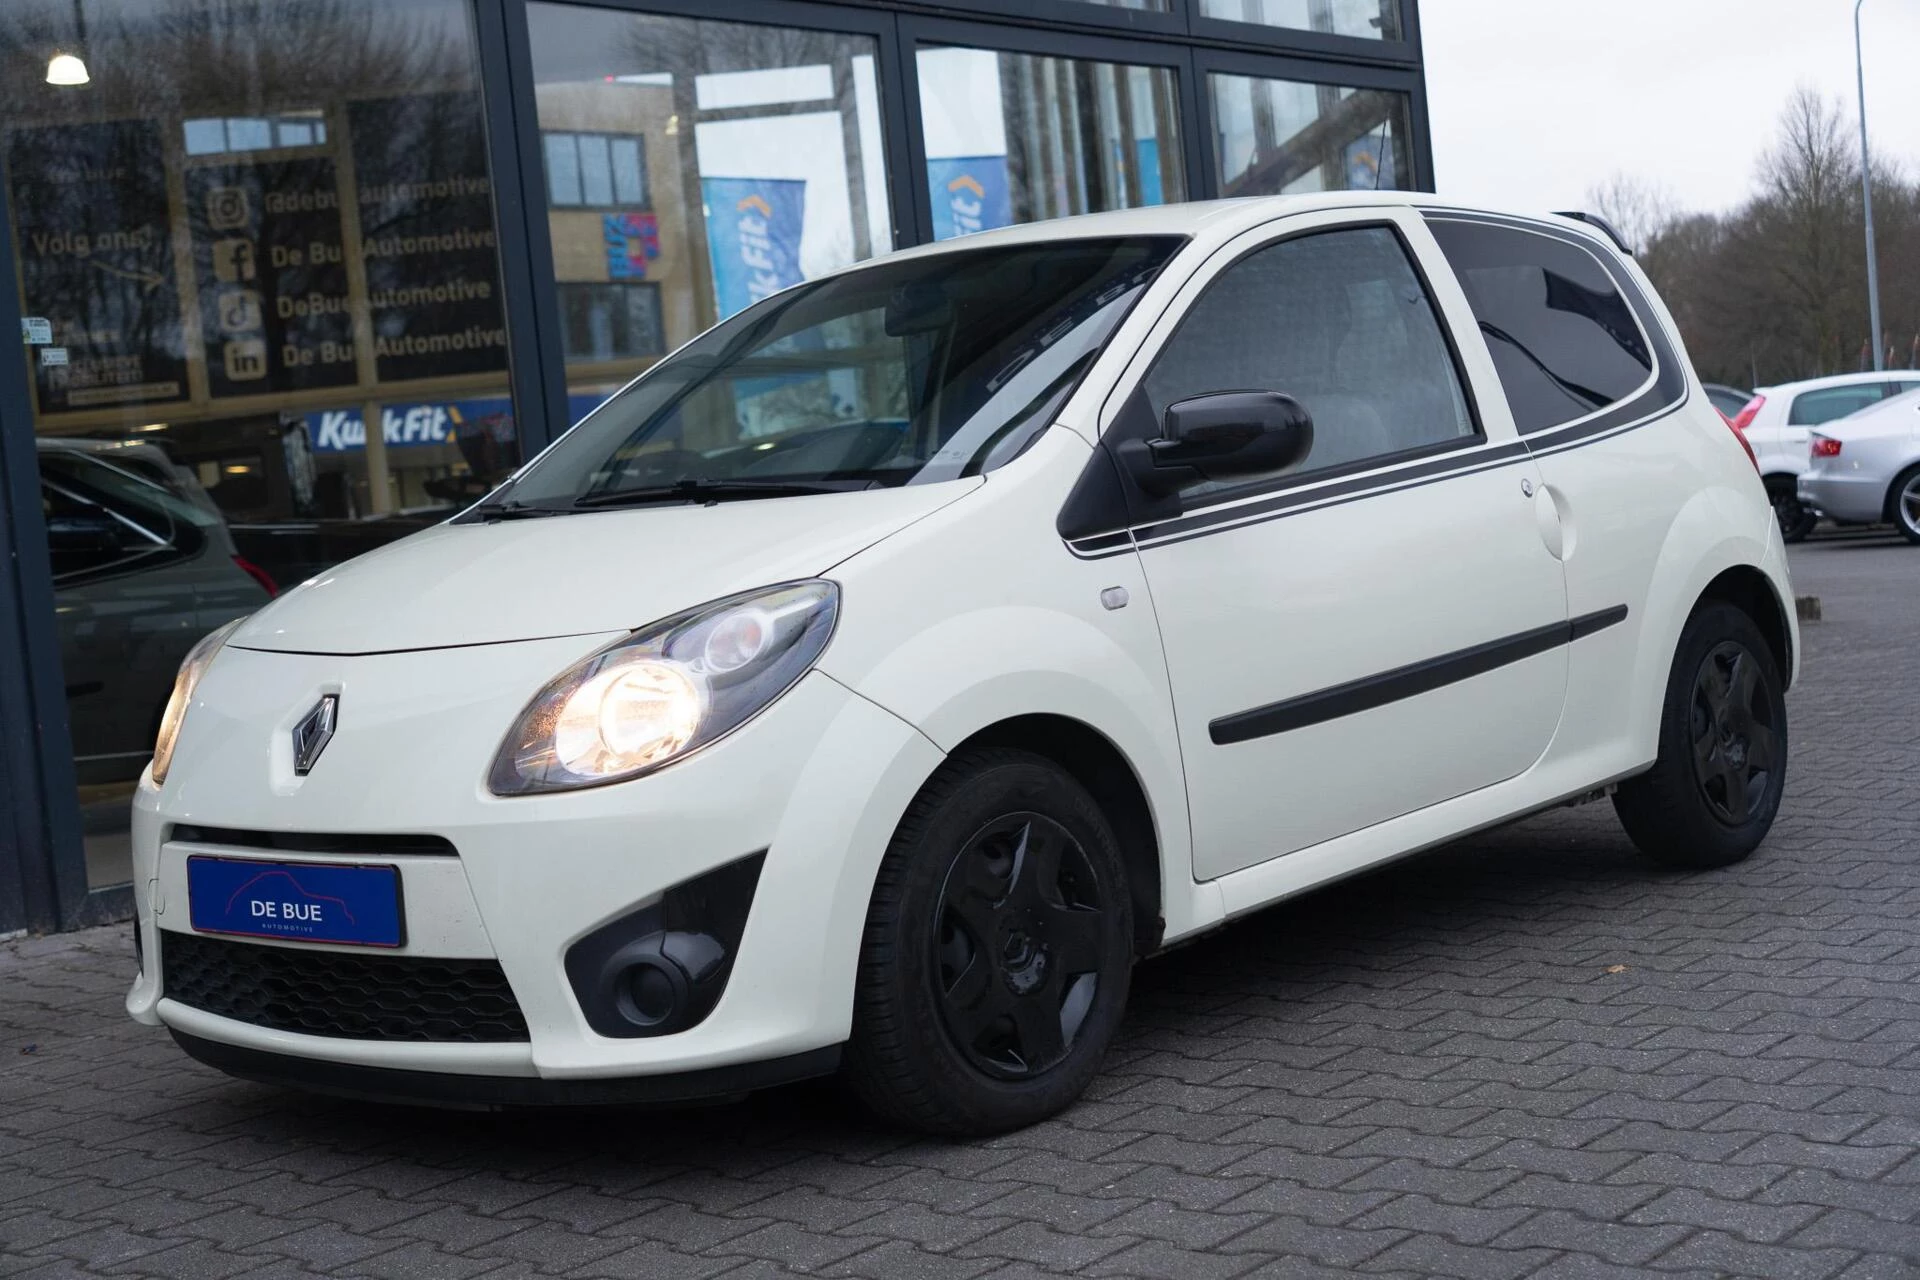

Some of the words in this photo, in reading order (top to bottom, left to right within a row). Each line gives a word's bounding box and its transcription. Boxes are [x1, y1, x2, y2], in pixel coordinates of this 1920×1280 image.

[32, 231, 91, 258] Volg
[271, 246, 303, 268] De
[309, 243, 342, 265] Bu
[362, 229, 497, 258] Automotive
[283, 345, 314, 368] De
[321, 341, 353, 363] Bu
[250, 900, 278, 918] DE
[282, 902, 323, 922] BUE
[261, 923, 313, 932] AUTOMOTIVE
